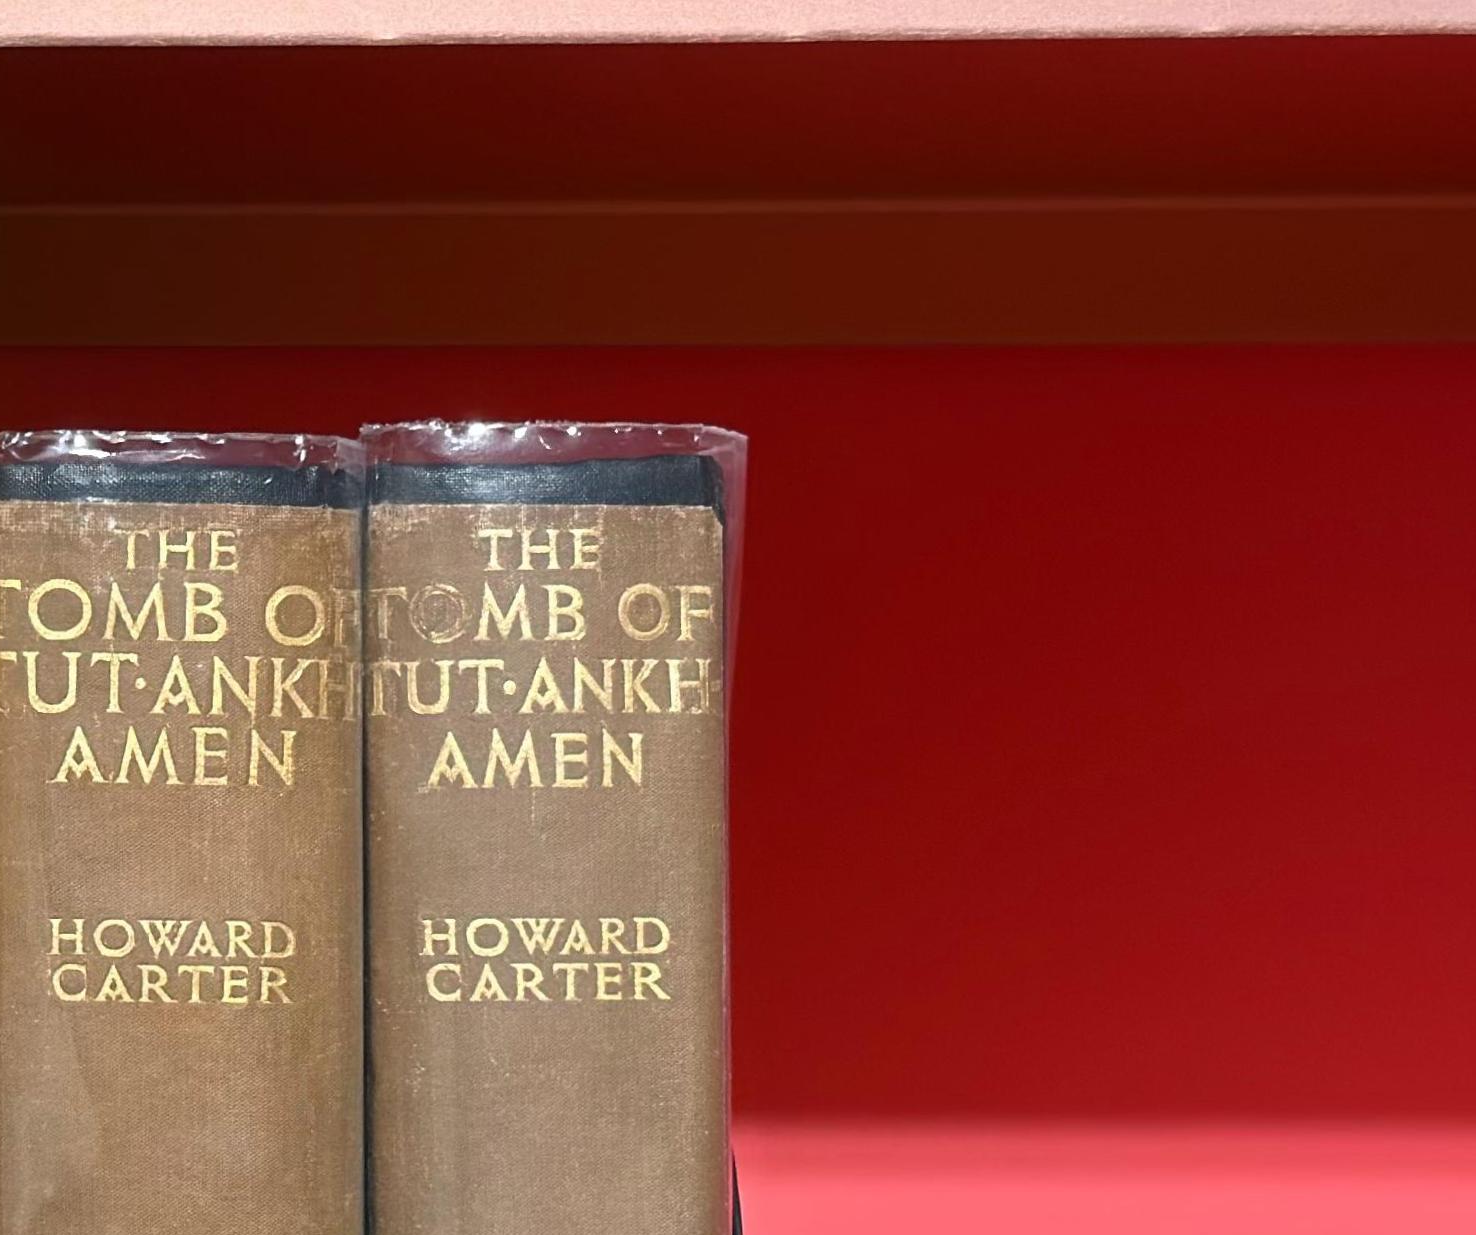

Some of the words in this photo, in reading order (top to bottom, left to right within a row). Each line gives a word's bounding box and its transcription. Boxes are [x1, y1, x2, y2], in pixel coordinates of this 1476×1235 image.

[121, 529, 239, 572] THE
[477, 529, 601, 571] THE
[367, 582, 586, 644] TOMB
[618, 582, 713, 641] OF
[47, 726, 297, 787] AMEN
[426, 728, 644, 789] AMEN
[47, 918, 298, 960] HOWARD
[419, 916, 670, 960] HOWARD
[50, 962, 290, 1003] CARTER
[426, 960, 671, 1002] CARTER
